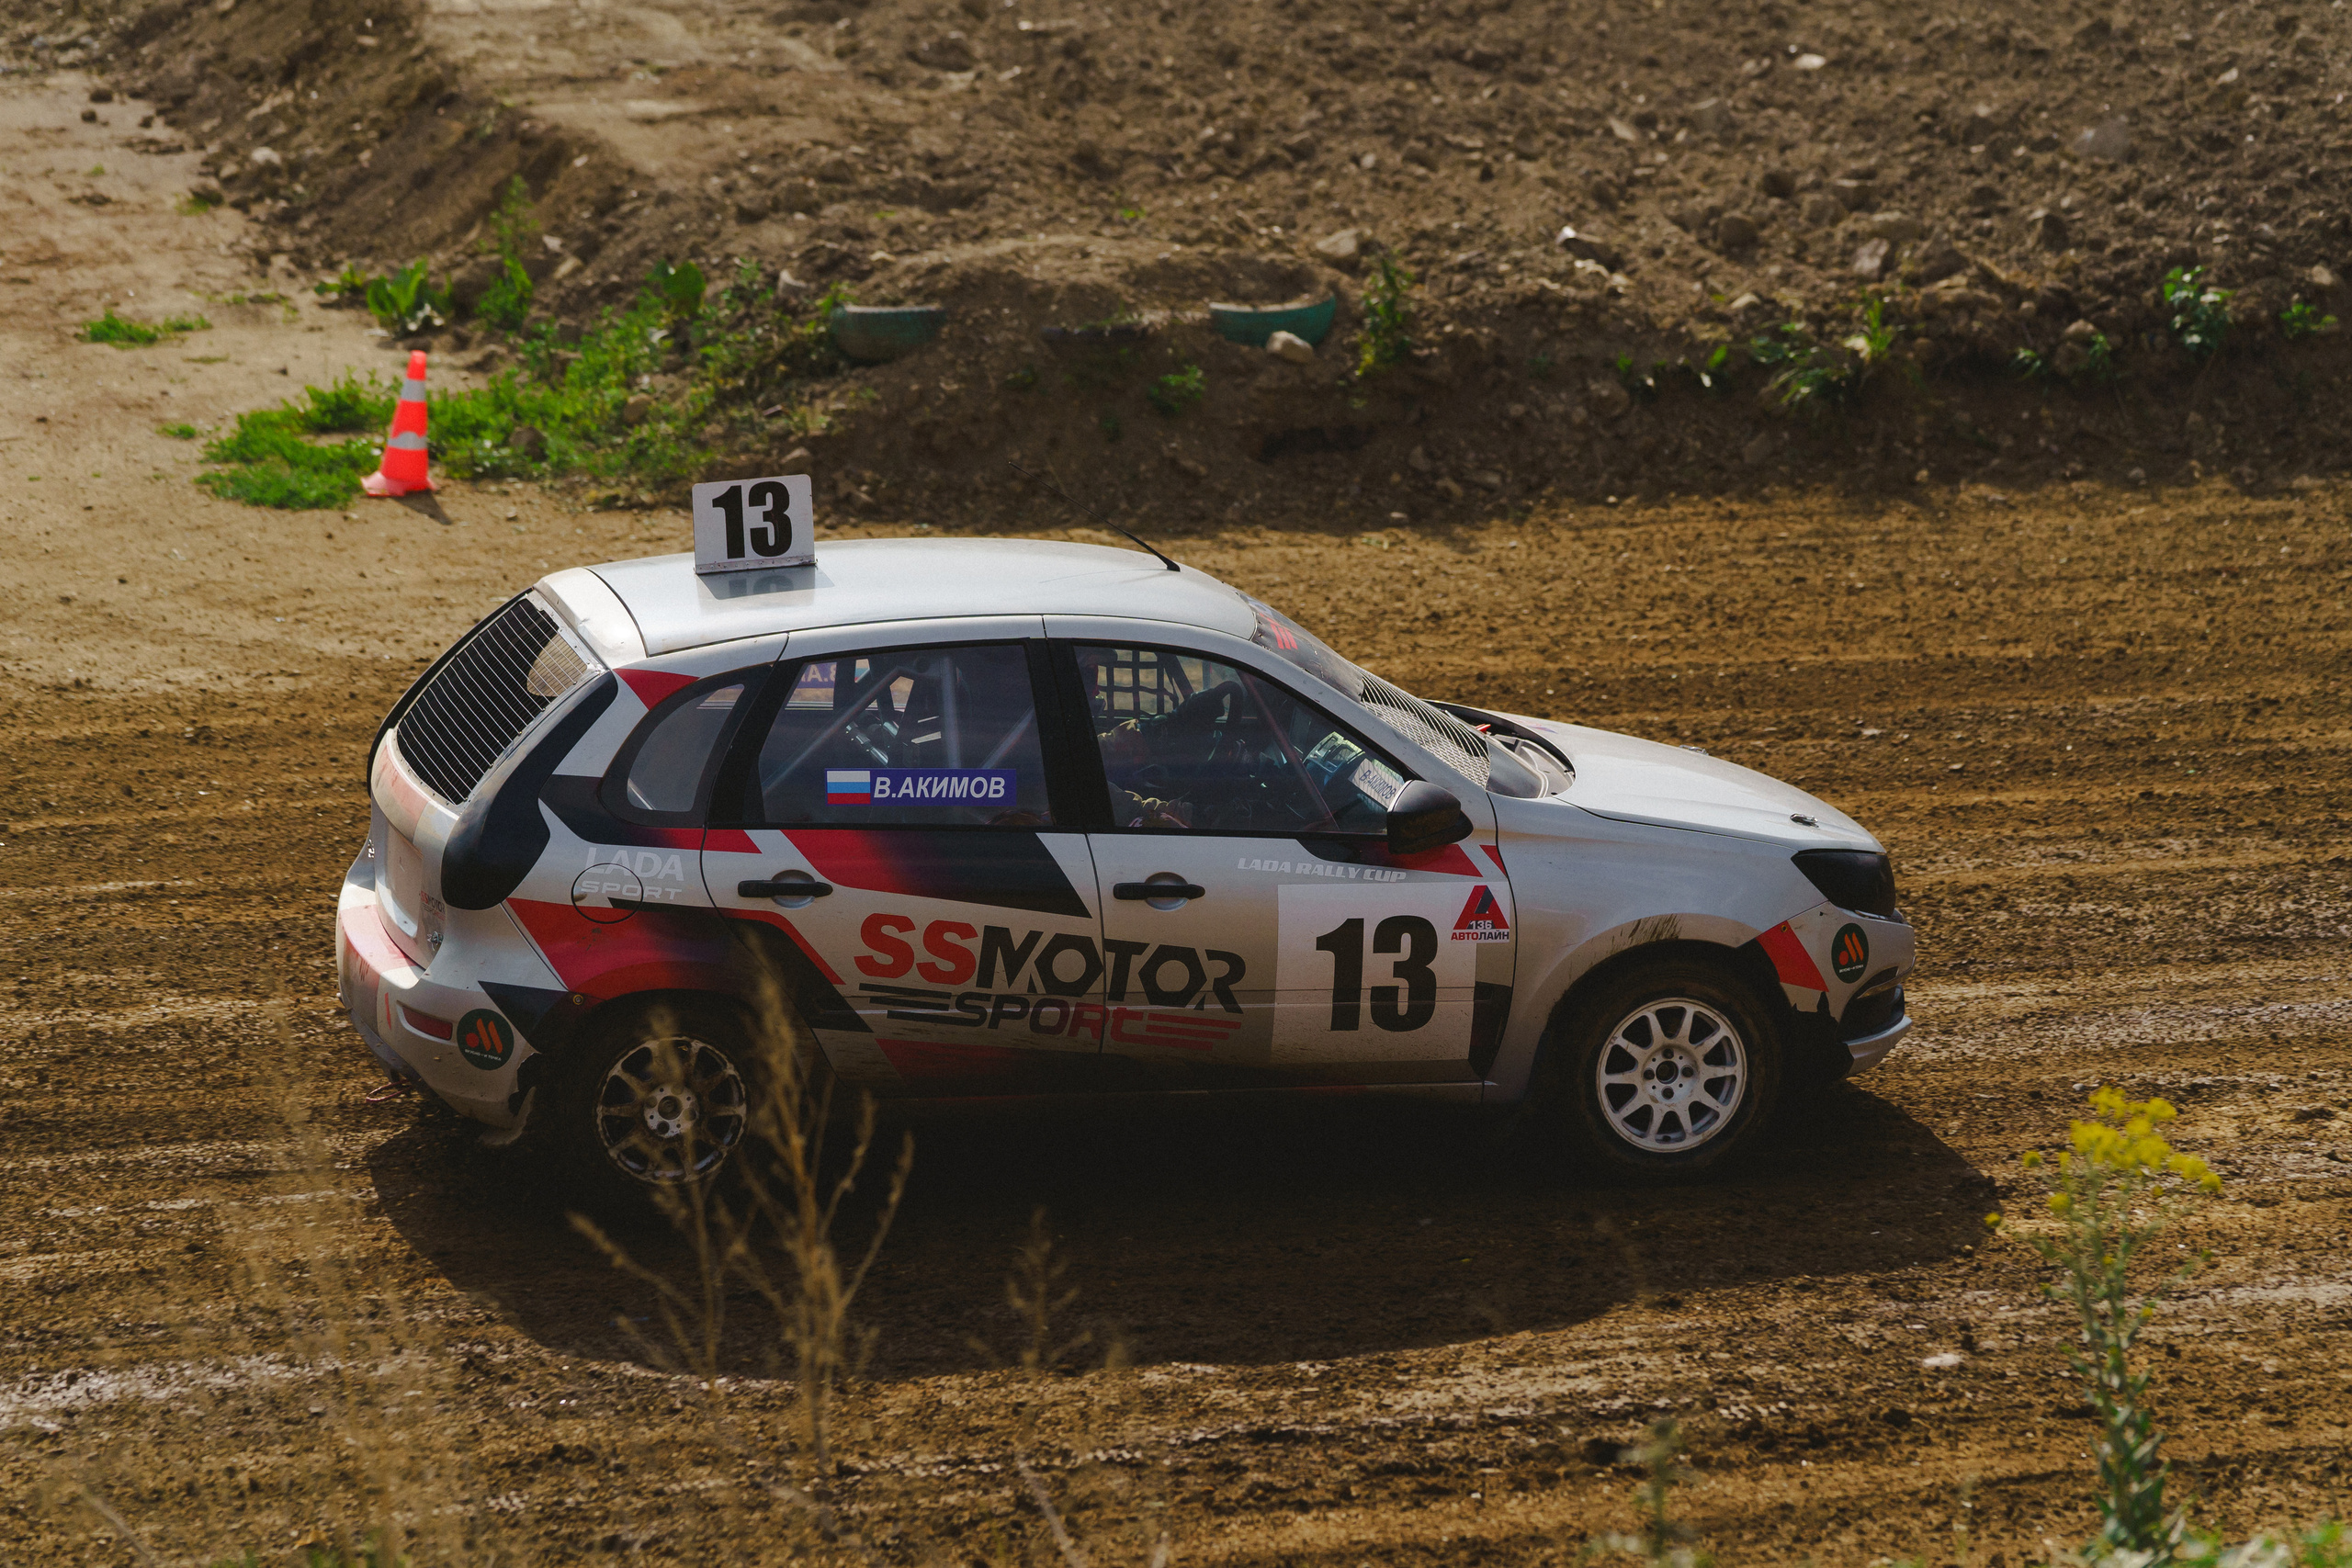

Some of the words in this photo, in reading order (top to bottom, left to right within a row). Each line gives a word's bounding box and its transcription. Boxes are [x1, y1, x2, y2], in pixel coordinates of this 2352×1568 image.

[712, 480, 793, 559] 13
[873, 776, 1006, 798] В.АКИМОВ
[585, 847, 684, 882] LADA
[1237, 857, 1292, 873] LADA
[1295, 862, 1362, 879] RALLY
[1363, 869, 1408, 883] CUP
[580, 880, 683, 900] SPORT
[1451, 930, 1510, 941] АВТОЛАЙН
[1469, 919, 1493, 931] 136
[854, 912, 1247, 1014] SSMOTOR
[1316, 914, 1439, 1032] 13
